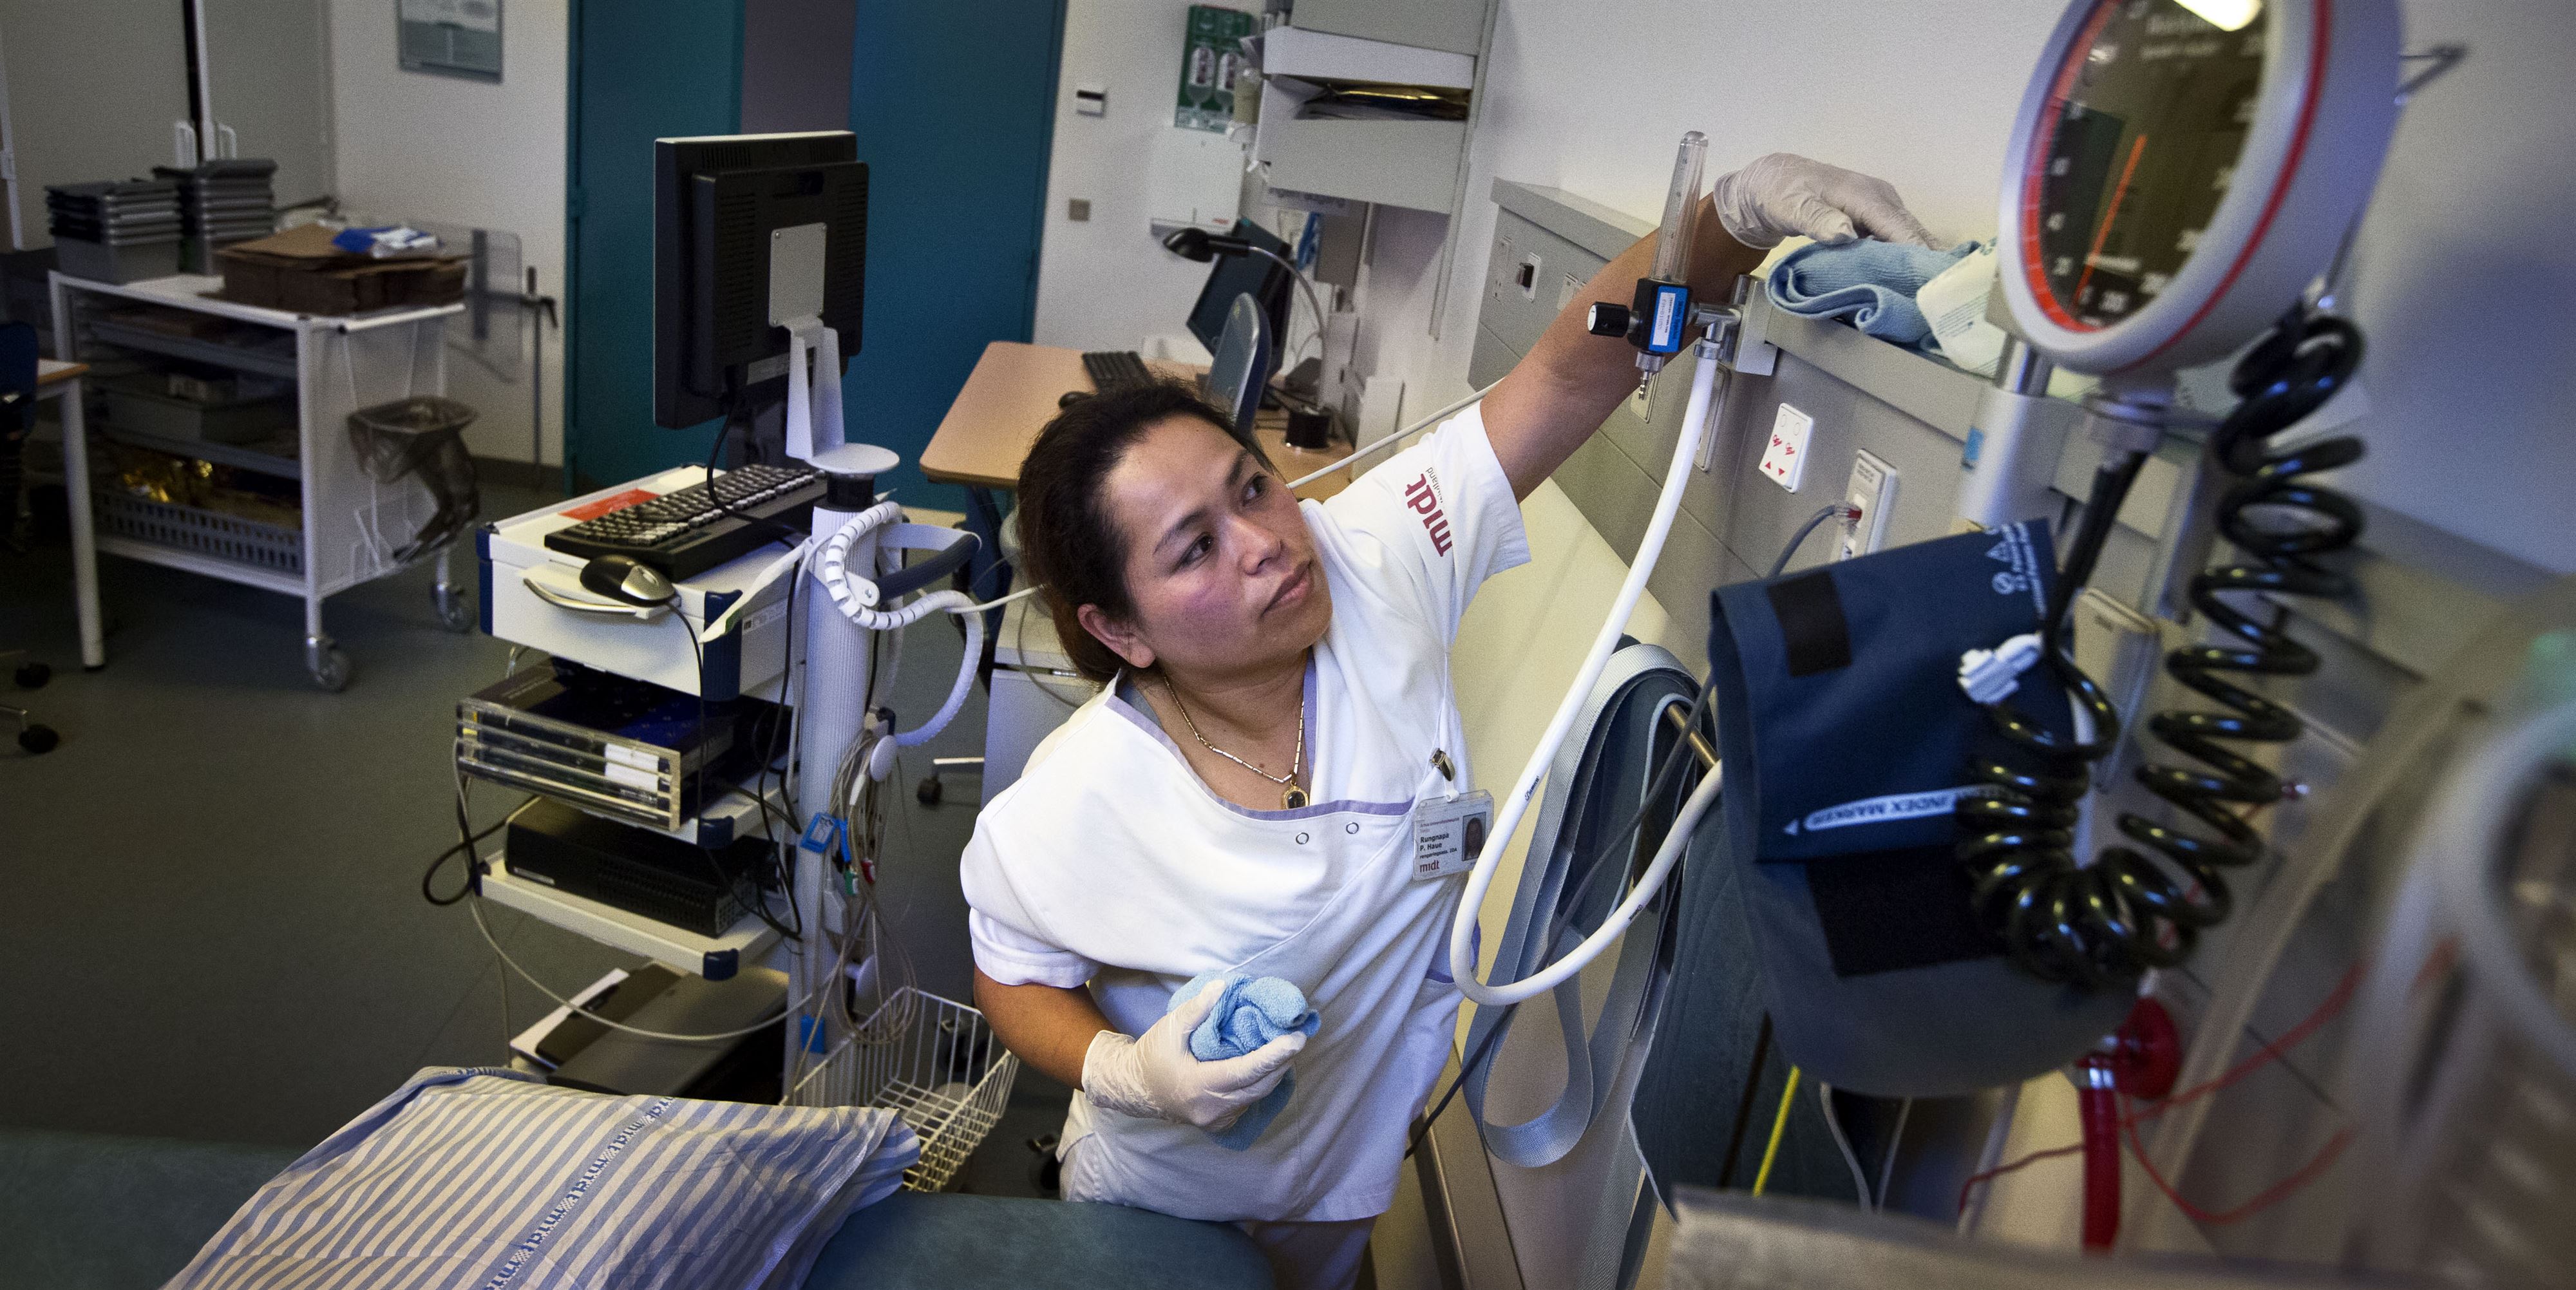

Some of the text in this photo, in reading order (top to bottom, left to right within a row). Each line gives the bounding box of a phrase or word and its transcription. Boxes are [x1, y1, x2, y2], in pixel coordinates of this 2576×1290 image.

[1405, 473, 1453, 558] midt
[1890, 795, 1949, 813] INDEX
[1420, 833, 1450, 844] Rungnapa
[1419, 860, 1440, 873] midt
